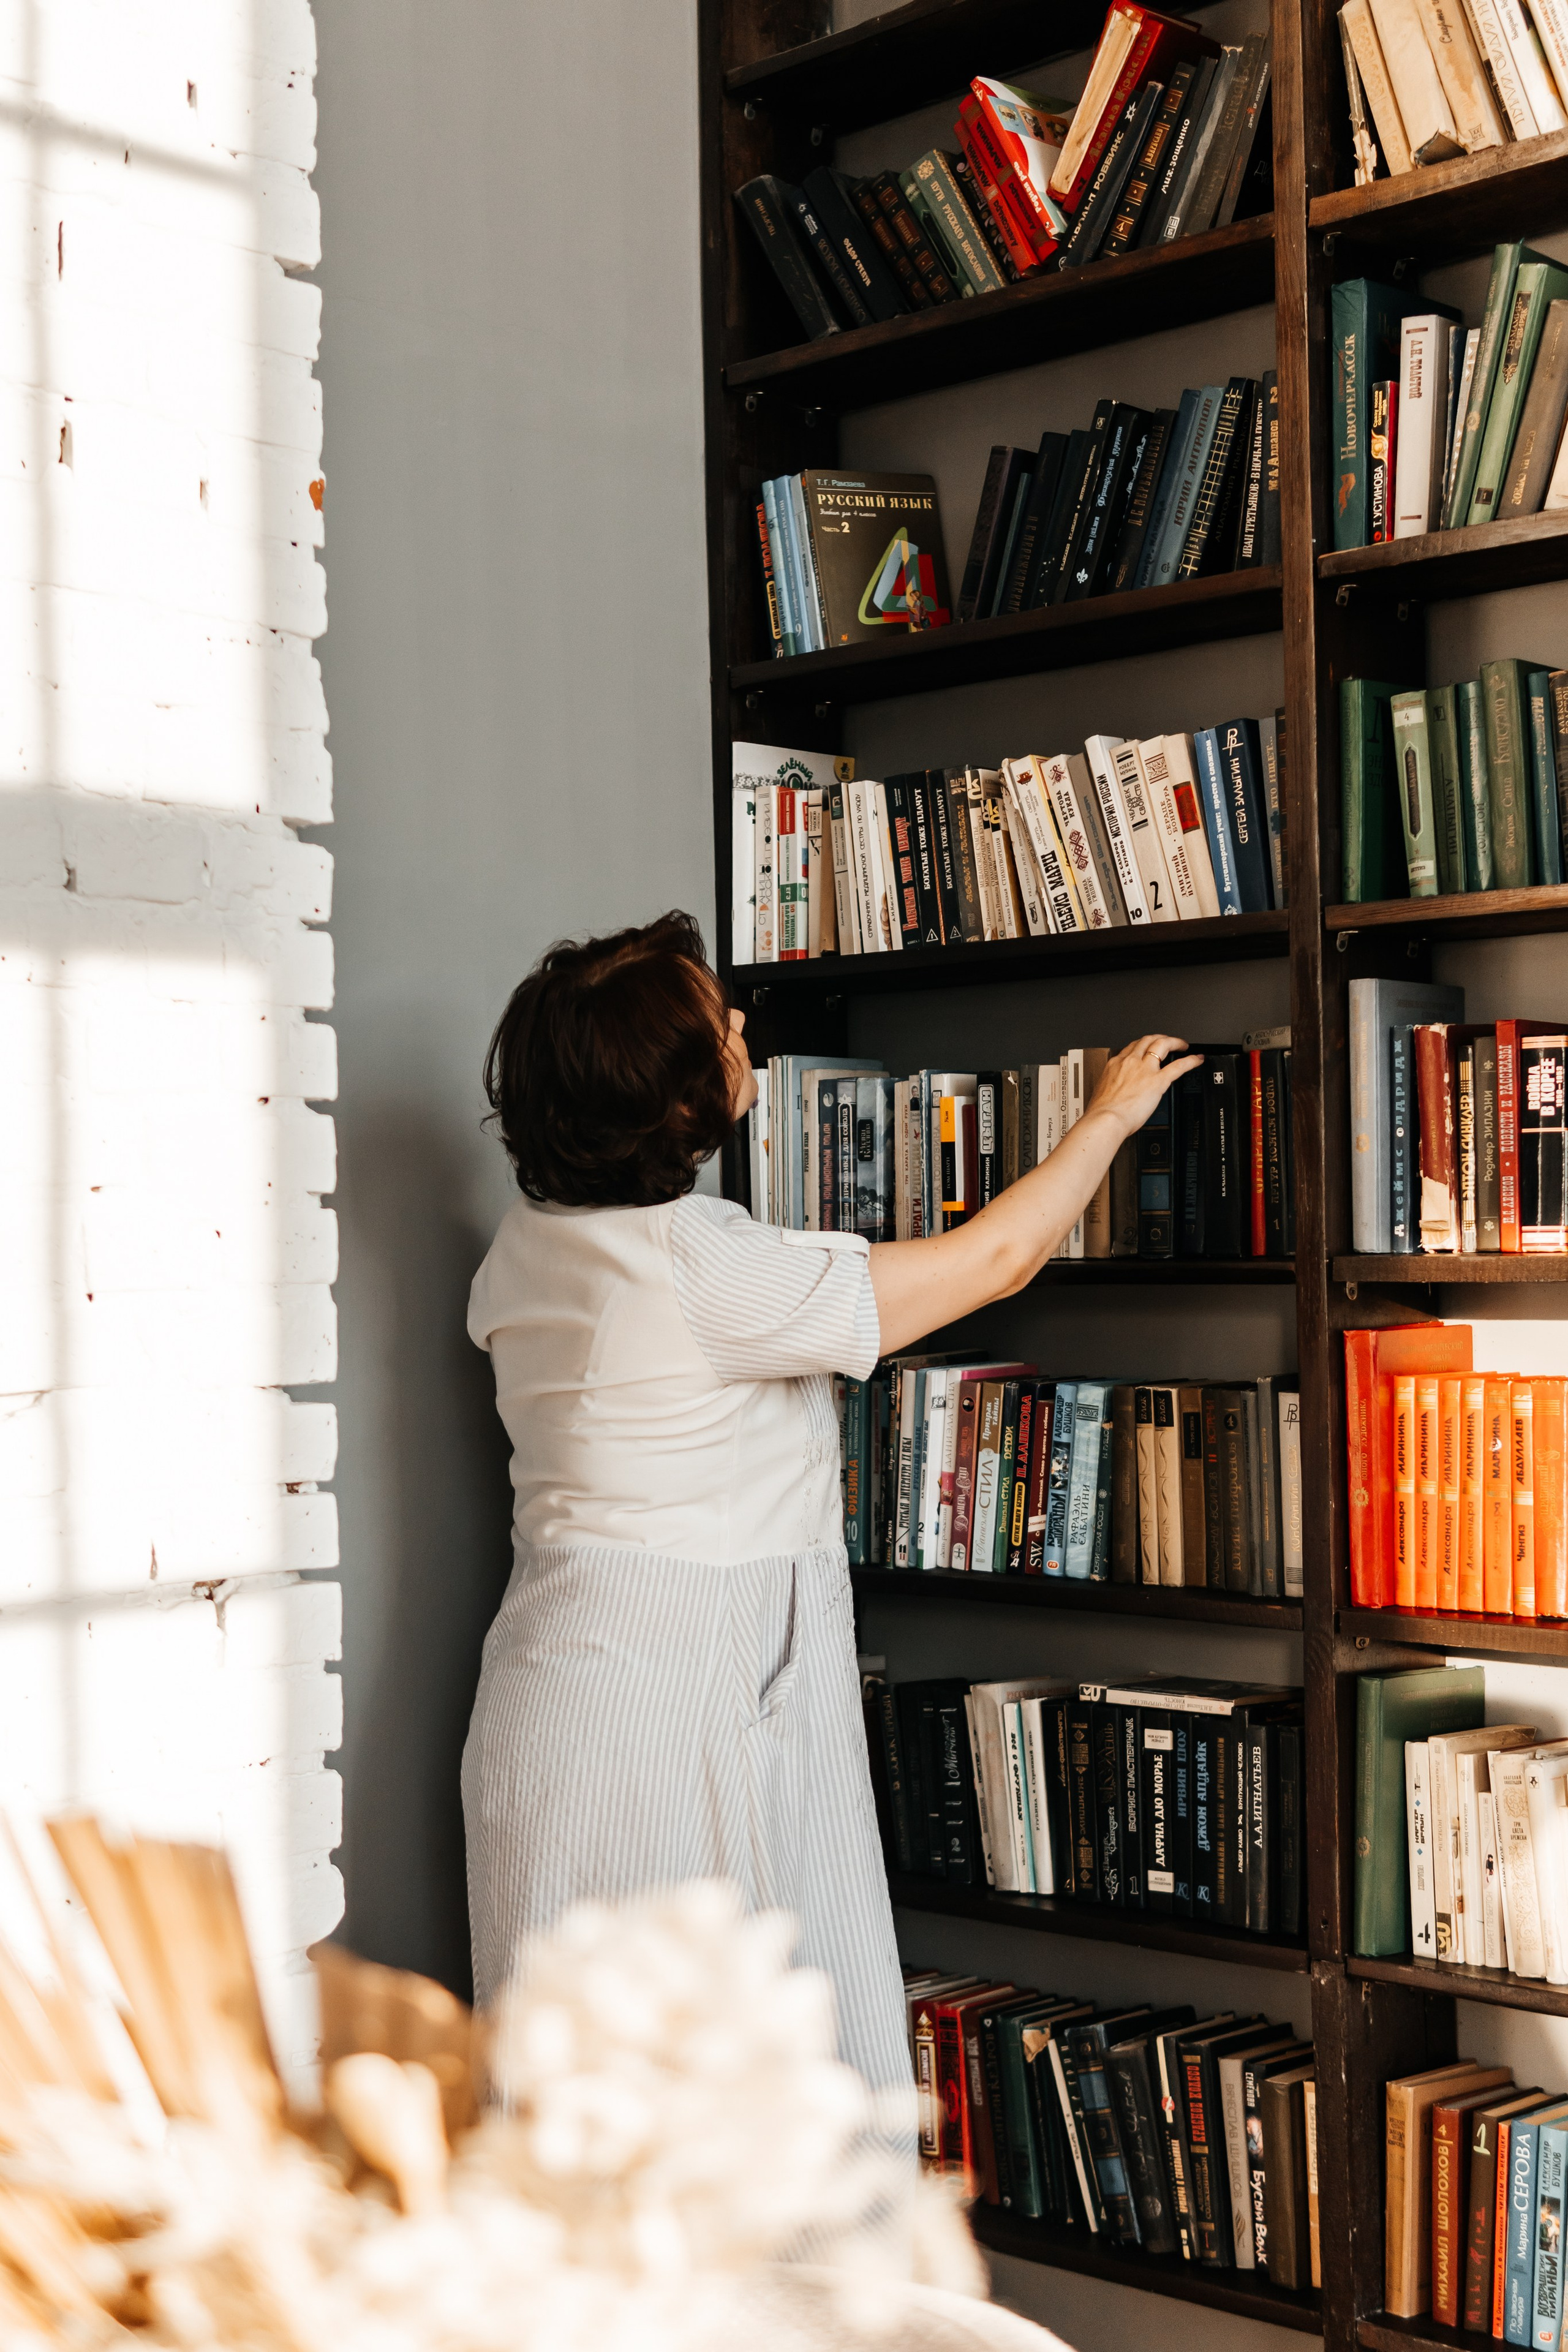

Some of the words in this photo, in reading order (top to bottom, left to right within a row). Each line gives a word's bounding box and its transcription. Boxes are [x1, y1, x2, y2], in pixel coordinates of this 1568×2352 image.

[1012, 159, 1028, 181] речь
[1022, 180, 1044, 213] Родная
[929, 179, 946, 202] ПУТИ
[941, 203, 966, 239] РУССКАГО
[959, 239, 987, 282] БОГОСЛОВИЯ
[1115, 220, 1125, 233] 4
[1173, 479, 1193, 526] ЮРИЙ
[1186, 398, 1213, 475] АНТРОПОВ
[817, 494, 886, 508] РУССКИЙ
[889, 497, 932, 509] ЯЗЫК
[1373, 464, 1383, 516] УСТИНОВА
[1403, 712, 1409, 721] 4
[1555, 687, 1566, 734] АЛЕКСЕЙ
[1119, 760, 1135, 771] РОБЕРТ
[1120, 766, 1136, 777] МУЗИЛЬ
[1205, 740, 1215, 775] сложном
[1096, 773, 1113, 804] РОССИИ
[1134, 783, 1147, 816] СВОЙСТВ
[1211, 783, 1221, 809] просто
[1229, 757, 1244, 805] ЗАЛЫГИН
[914, 788, 924, 823] ПЛАЧУТ
[936, 788, 946, 823] ПЛАЧУТ
[1055, 789, 1069, 827] ЧЕРТОВА
[1063, 791, 1075, 818] КУКЛА
[1104, 804, 1121, 839] ИСТОРИЯ
[1123, 788, 1136, 821] ЧЕЛОВЕК
[1160, 800, 1172, 835] СЕРДЦЕ
[1162, 785, 1178, 833] БОНИВУРА
[1215, 812, 1224, 832] учет:
[918, 825, 927, 850] ТОЖЕ
[940, 825, 949, 848] ТОЖЕ
[1235, 808, 1248, 844] СЕРГЕЙ
[860, 853, 870, 896] МЕДИЦИНСКОЙ
[920, 851, 930, 889] БОГАТЫЕ
[943, 851, 953, 889] БОГАТЫЕ
[975, 851, 984, 888] МЕЩАНСКОЕ
[1040, 850, 1065, 891] МАРШ
[1170, 854, 1188, 899] ДМИТРИЙ
[1177, 845, 1194, 896] НАГИШКИН
[1216, 834, 1232, 892] Бухгалтерский
[1082, 878, 1093, 905] ЗИНАИДА
[1086, 875, 1097, 902] ГИППИУС
[1150, 881, 1163, 911] 2
[865, 899, 873, 937] СПРАВОЧНИК
[1050, 892, 1077, 932] НЬЕЙО
[1130, 908, 1142, 920] 10
[1526, 1065, 1540, 1109] ВОЙНА
[1540, 1057, 1555, 1101] КОРЕЕ
[981, 1088, 993, 1150] ЦЫГАН
[1021, 1077, 1032, 1167] САПОЖНИКОВ
[1460, 1094, 1473, 1149] СИНКЛЕР
[1484, 1090, 1493, 1138] ЗИЛАЗНИ
[1540, 1105, 1555, 1115] В
[911, 1143, 921, 1193] РОССИИ
[1461, 1152, 1473, 1197] ЭПТОН
[1484, 1142, 1495, 1181] Роджер
[912, 1198, 922, 1237] ВРАГИ
[946, 1381, 955, 1409] СТИЛ
[990, 1397, 1000, 1425] тайны
[982, 1401, 993, 1439] Призрак
[1017, 1395, 1032, 1463] ДАШКОВА
[1054, 1395, 1065, 1438] АЛЕКСАНДР
[1062, 1401, 1074, 1433] БУШКОВ
[902, 1438, 912, 1452] ВЕКА
[944, 1413, 953, 1467] ДАНИЭЛА
[1443, 1417, 1452, 1484] МАРИНИНА
[1515, 1419, 1524, 1484] АБДУЛЛАЕВ
[847, 1459, 858, 1515] ФИЗИКА
[899, 1464, 911, 1501] ЛИТЕРАТУРА
[978, 1459, 993, 1509] СТИЛ
[1016, 1464, 1027, 1477] П.
[1227, 1441, 1241, 1521] ТРИФОНОВ
[898, 1502, 910, 1528] РУССКАЯ
[974, 1508, 988, 1555] Даниэла
[1068, 1495, 1084, 1544] РАФАЭЛЬ
[1075, 1485, 1093, 1545] САБАТИНИ
[1397, 1501, 1406, 1564] Александра
[1420, 1501, 1428, 1567] Александра
[1466, 1501, 1474, 1570] Александра
[1230, 1526, 1241, 1570] ЮРИЙ
[1443, 1506, 1452, 1575] Александра
[1125, 1717, 1136, 1788] ПАСТЕРНАК
[1177, 1727, 1186, 1762] ШОУ
[1153, 1754, 1163, 1794] МОРЬЕ
[1195, 1741, 1209, 1801] АПДАЙК
[1127, 1790, 1137, 1831] БОРИС
[1155, 1797, 1164, 1819] ДЮ
[1177, 1768, 1186, 1817] ИРВИН
[1155, 1822, 1165, 1866] ДАФНА
[1197, 1805, 1210, 1851] ДЖОН
[1129, 1876, 1139, 1894] 1
[1185, 2064, 1202, 2100] КОЛЕСО
[1188, 2100, 1207, 2143] КРАСНОЕ
[1224, 2082, 1239, 2138] ВЯЧЕСЛАВ
[1438, 2124, 1447, 2136] 4
[1228, 2142, 1245, 2199] ШИШКОВ
[1513, 2133, 1531, 2212] СЕРОВА
[1539, 2141, 1553, 2192] АЛЕКСАНДР
[1550, 2152, 1561, 2187] БУШКОВ
[1438, 2145, 1447, 2231] ШОЛОХОВ
[1517, 2212, 1529, 2259] Марина
[1438, 2235, 1447, 2309] МИХАИЛ
[1538, 2253, 1548, 2317] ВОЗВРАЩЕНИЕ
[1548, 2254, 1559, 2320] ПИРАНЬИ
[1510, 2318, 1517, 2331] По
